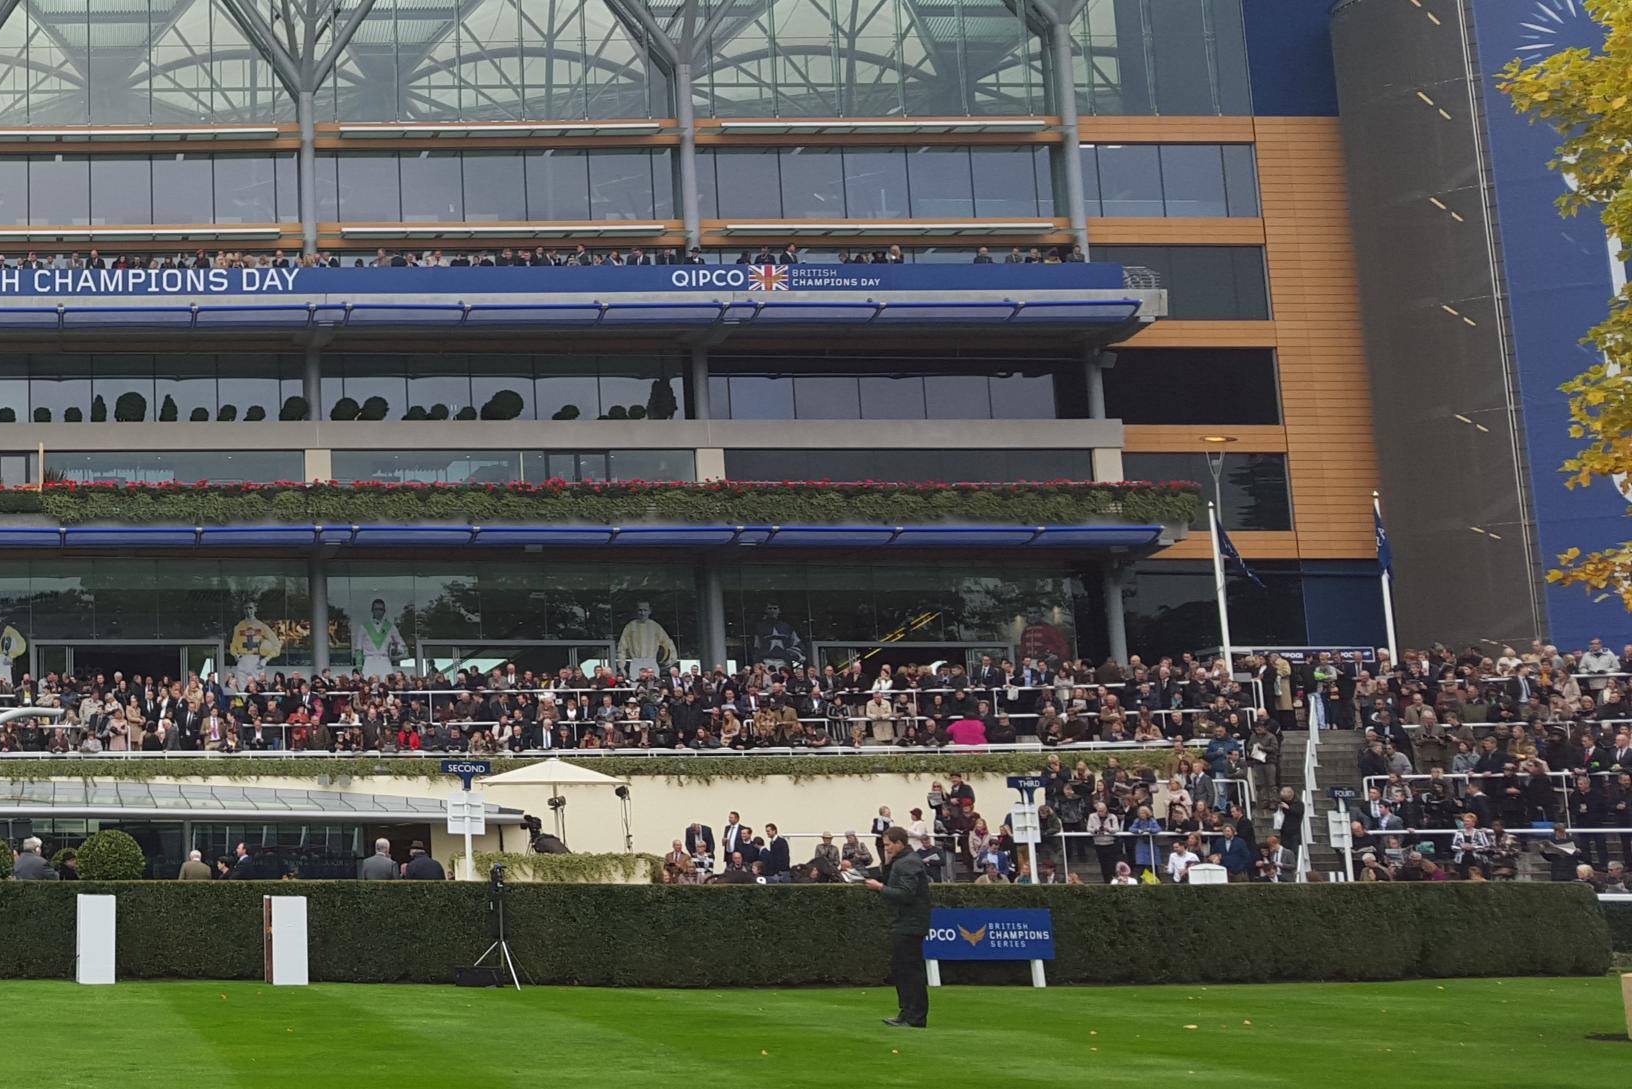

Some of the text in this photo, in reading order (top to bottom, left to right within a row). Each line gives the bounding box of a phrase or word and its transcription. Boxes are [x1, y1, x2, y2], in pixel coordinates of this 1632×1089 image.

[792, 268, 838, 277] BRITISH
[33, 268, 229, 293] CHAMPIONS
[241, 267, 300, 292] DAY
[671, 269, 744, 287] QIPCO
[792, 278, 881, 287] CHAMPIONS DAY
[448, 764, 486, 773] SECOND
[988, 922, 1028, 930] BRITISH
[926, 928, 956, 941] PCO
[989, 931, 1050, 940] CHAMPIONS
[991, 940, 1026, 948] SERIES
